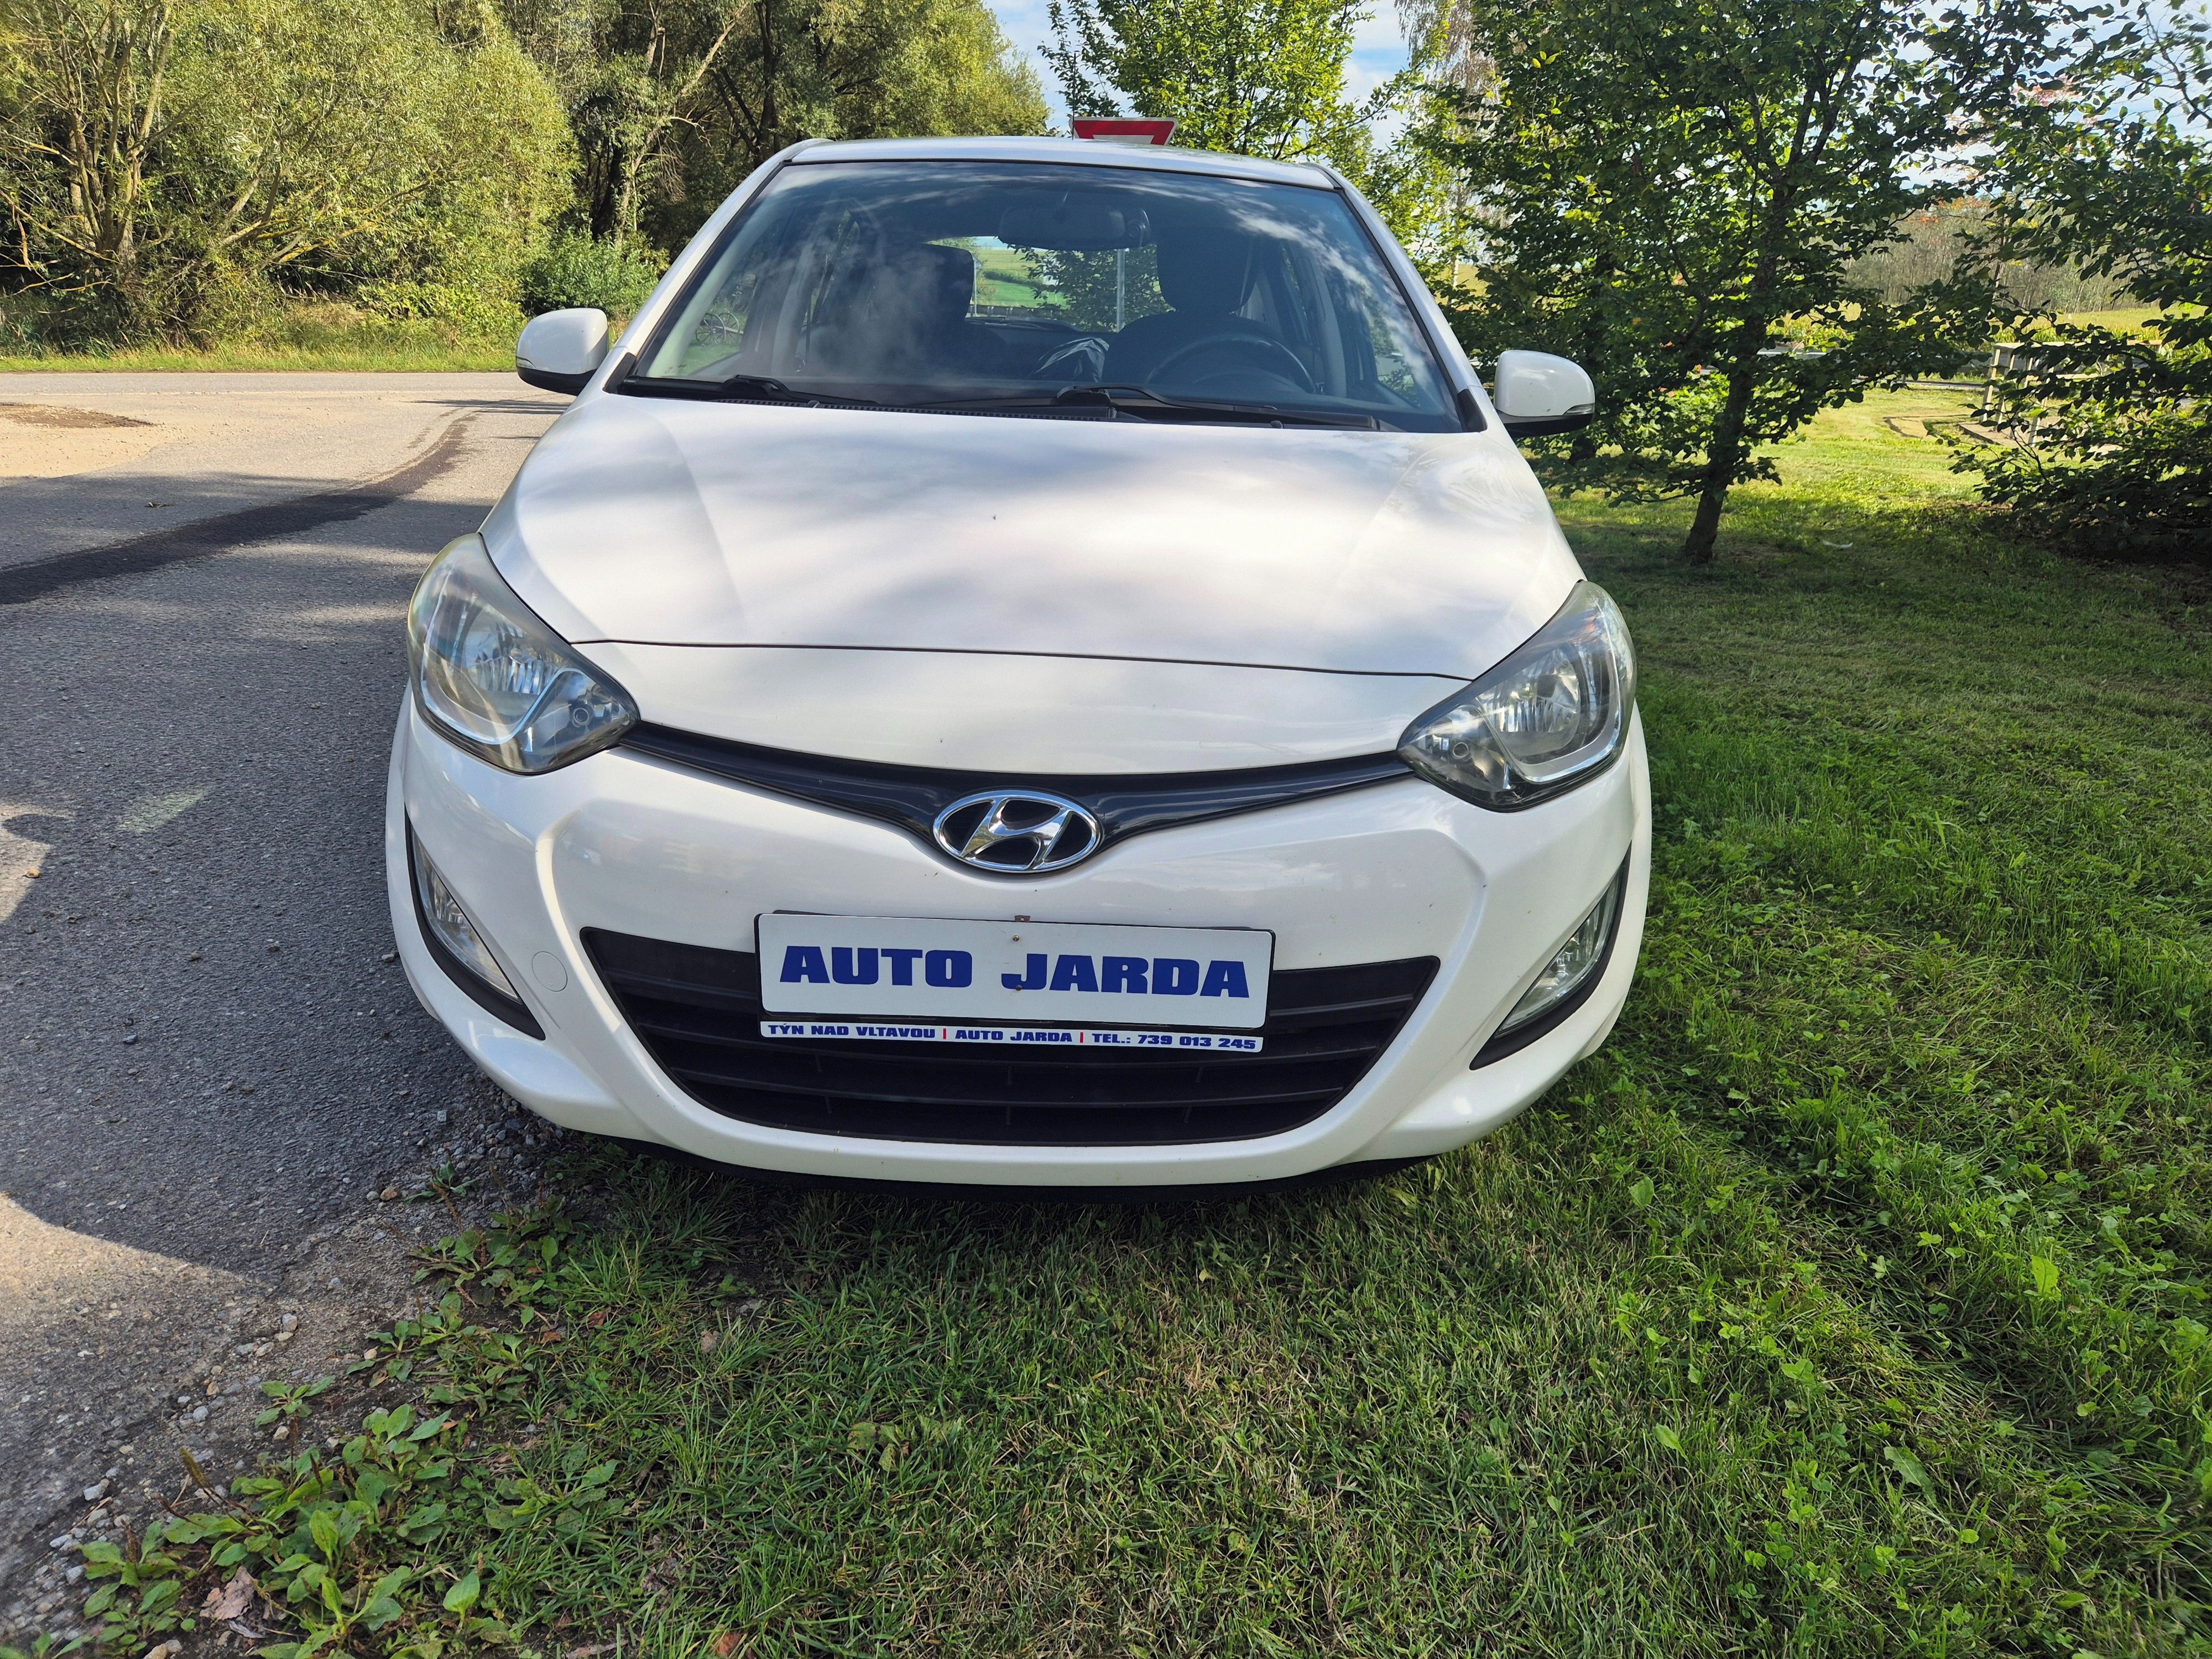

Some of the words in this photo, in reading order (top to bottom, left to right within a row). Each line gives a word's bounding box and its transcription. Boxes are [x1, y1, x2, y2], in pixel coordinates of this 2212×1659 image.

[780, 945, 973, 989] AUTO
[1000, 953, 1250, 999] JARDA
[768, 1023, 805, 1035] TÝN
[811, 1025, 850, 1036] NAD
[855, 1026, 936, 1039] VLTAVOU
[955, 1029, 1004, 1041] AUTO
[1009, 1031, 1073, 1044] JARDA
[1092, 1032, 1131, 1044] TEL.:
[1138, 1034, 1173, 1046] 739
[1178, 1036, 1212, 1047] 013
[1218, 1037, 1256, 1050] 245
